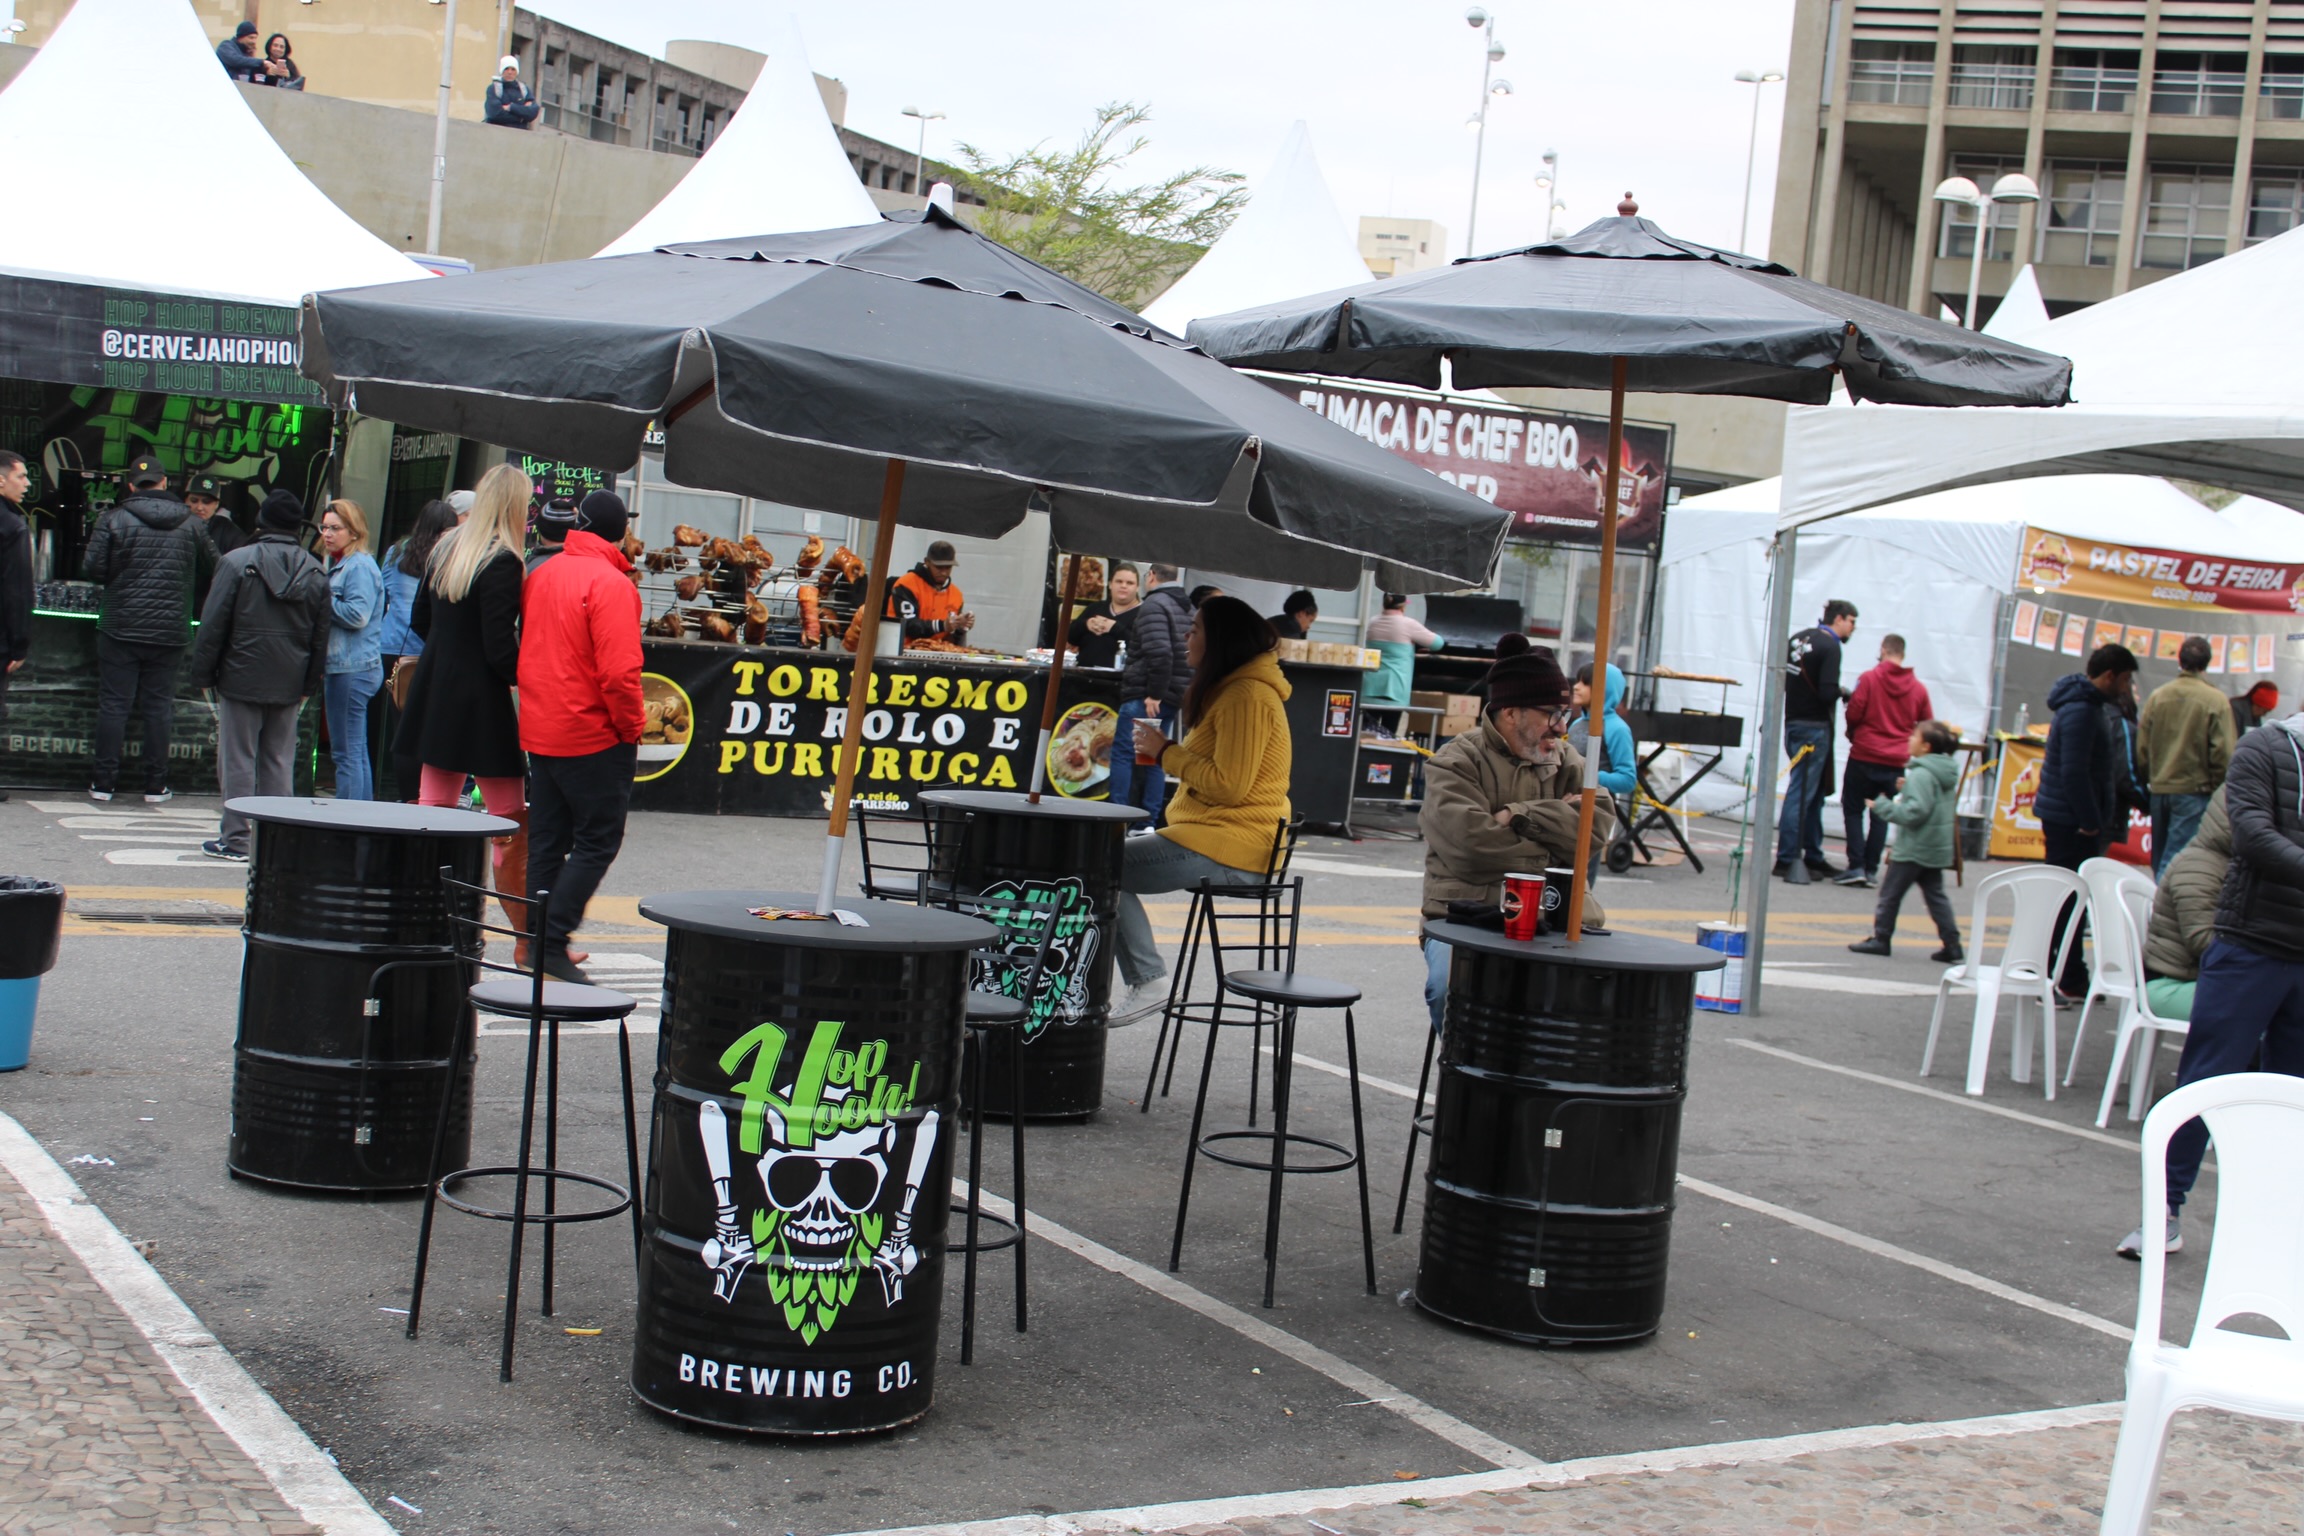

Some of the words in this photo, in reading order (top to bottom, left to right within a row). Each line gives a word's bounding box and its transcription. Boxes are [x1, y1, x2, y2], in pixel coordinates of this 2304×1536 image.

[104, 299, 148, 327] HOP
[155, 302, 214, 332] HOOH
[221, 306, 298, 335] BREWI
[102, 329, 299, 366] @CERVEJAHOPHO
[104, 360, 148, 389] HOP
[155, 363, 214, 392] HOOH
[1414, 406, 1453, 456] DE
[1454, 412, 1524, 465] CHEF
[1525, 421, 1580, 472] BBQ
[522, 455, 553, 477] HOP
[2088, 546, 2183, 583] PASTEL
[2184, 560, 2220, 587] DE
[2219, 565, 2287, 592] FEIRA
[725, 701, 797, 736] DE
[820, 706, 966, 746] ROLO
[987, 717, 1021, 751] E
[679, 1353, 851, 1398] BREWING
[877, 1360, 918, 1393] CO.
